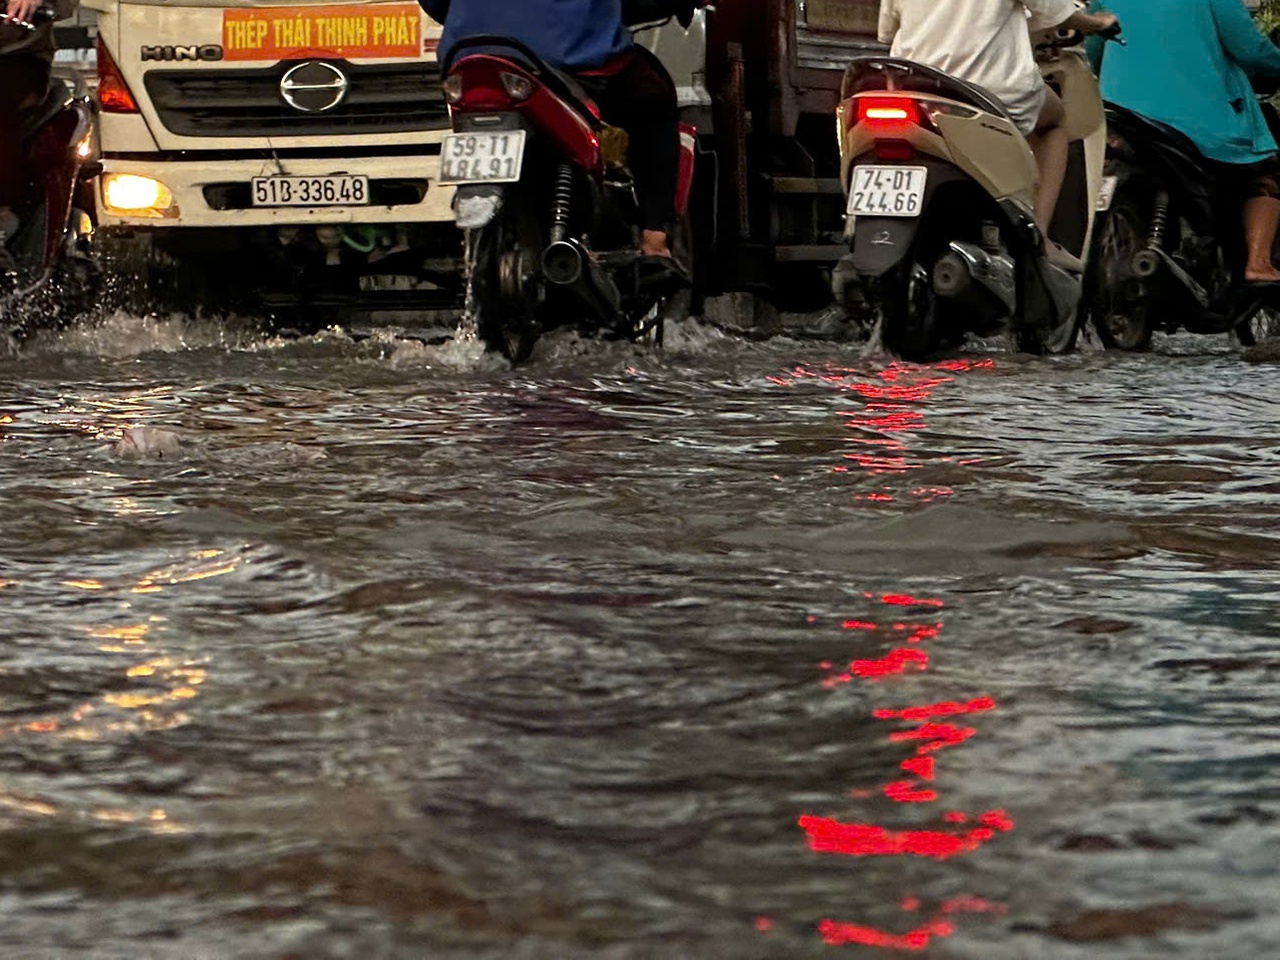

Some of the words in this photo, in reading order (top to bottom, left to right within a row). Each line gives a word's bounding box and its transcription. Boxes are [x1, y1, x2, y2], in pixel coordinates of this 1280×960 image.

[226, 10, 268, 49] THÉP
[273, 12, 312, 48] THÁI
[315, 16, 368, 53] THỊNH
[373, 9, 419, 46] PHÁT
[140, 44, 223, 61] HINO
[453, 135, 508, 156] 59-T1
[864, 170, 913, 190] 74-D1
[853, 192, 918, 212] 244.66
